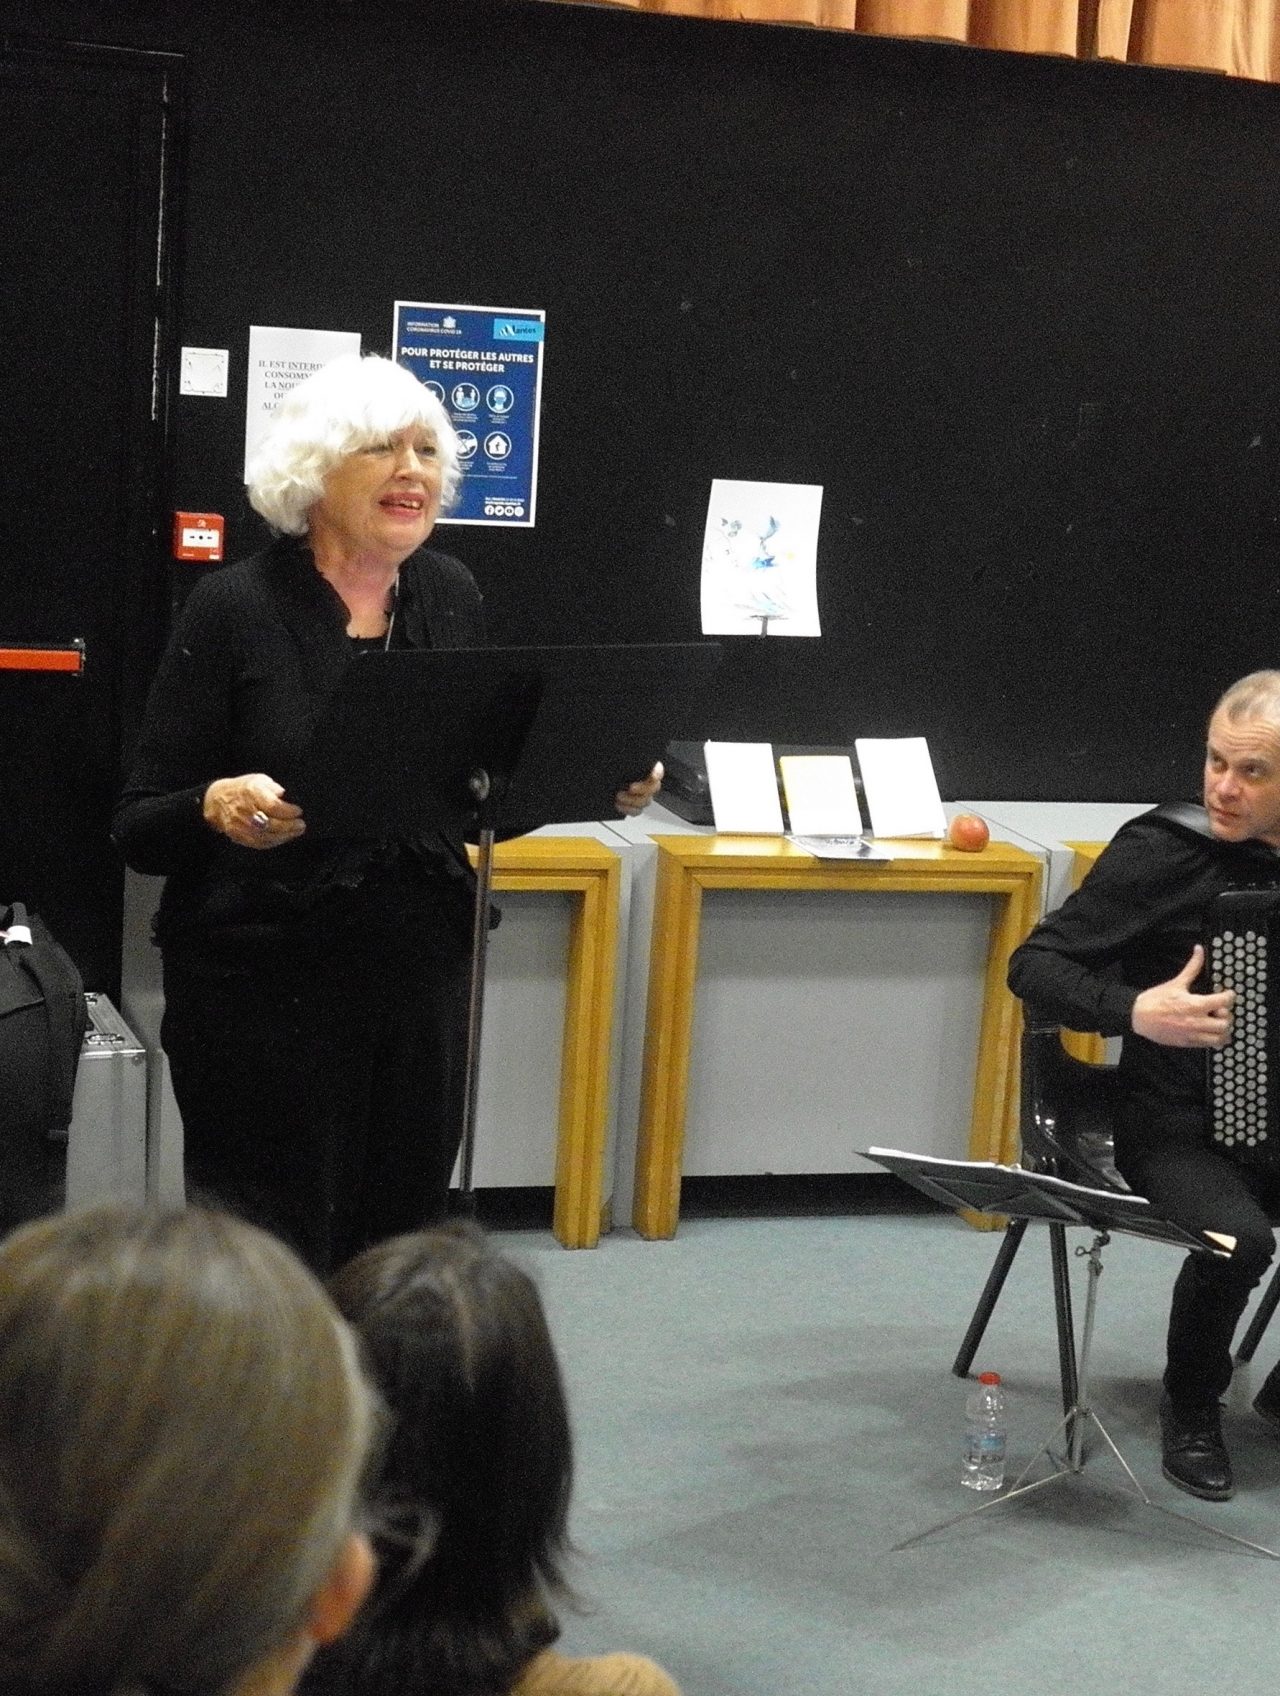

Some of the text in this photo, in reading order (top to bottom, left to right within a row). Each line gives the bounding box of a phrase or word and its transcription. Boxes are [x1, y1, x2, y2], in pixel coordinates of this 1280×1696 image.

[401, 347, 534, 363] POUR PROTÉGER LES AUTRES
[258, 360, 267, 368] IL
[269, 360, 287, 369] EST
[430, 360, 505, 373] ET SE PROTÉGER
[264, 381, 277, 389] LA
